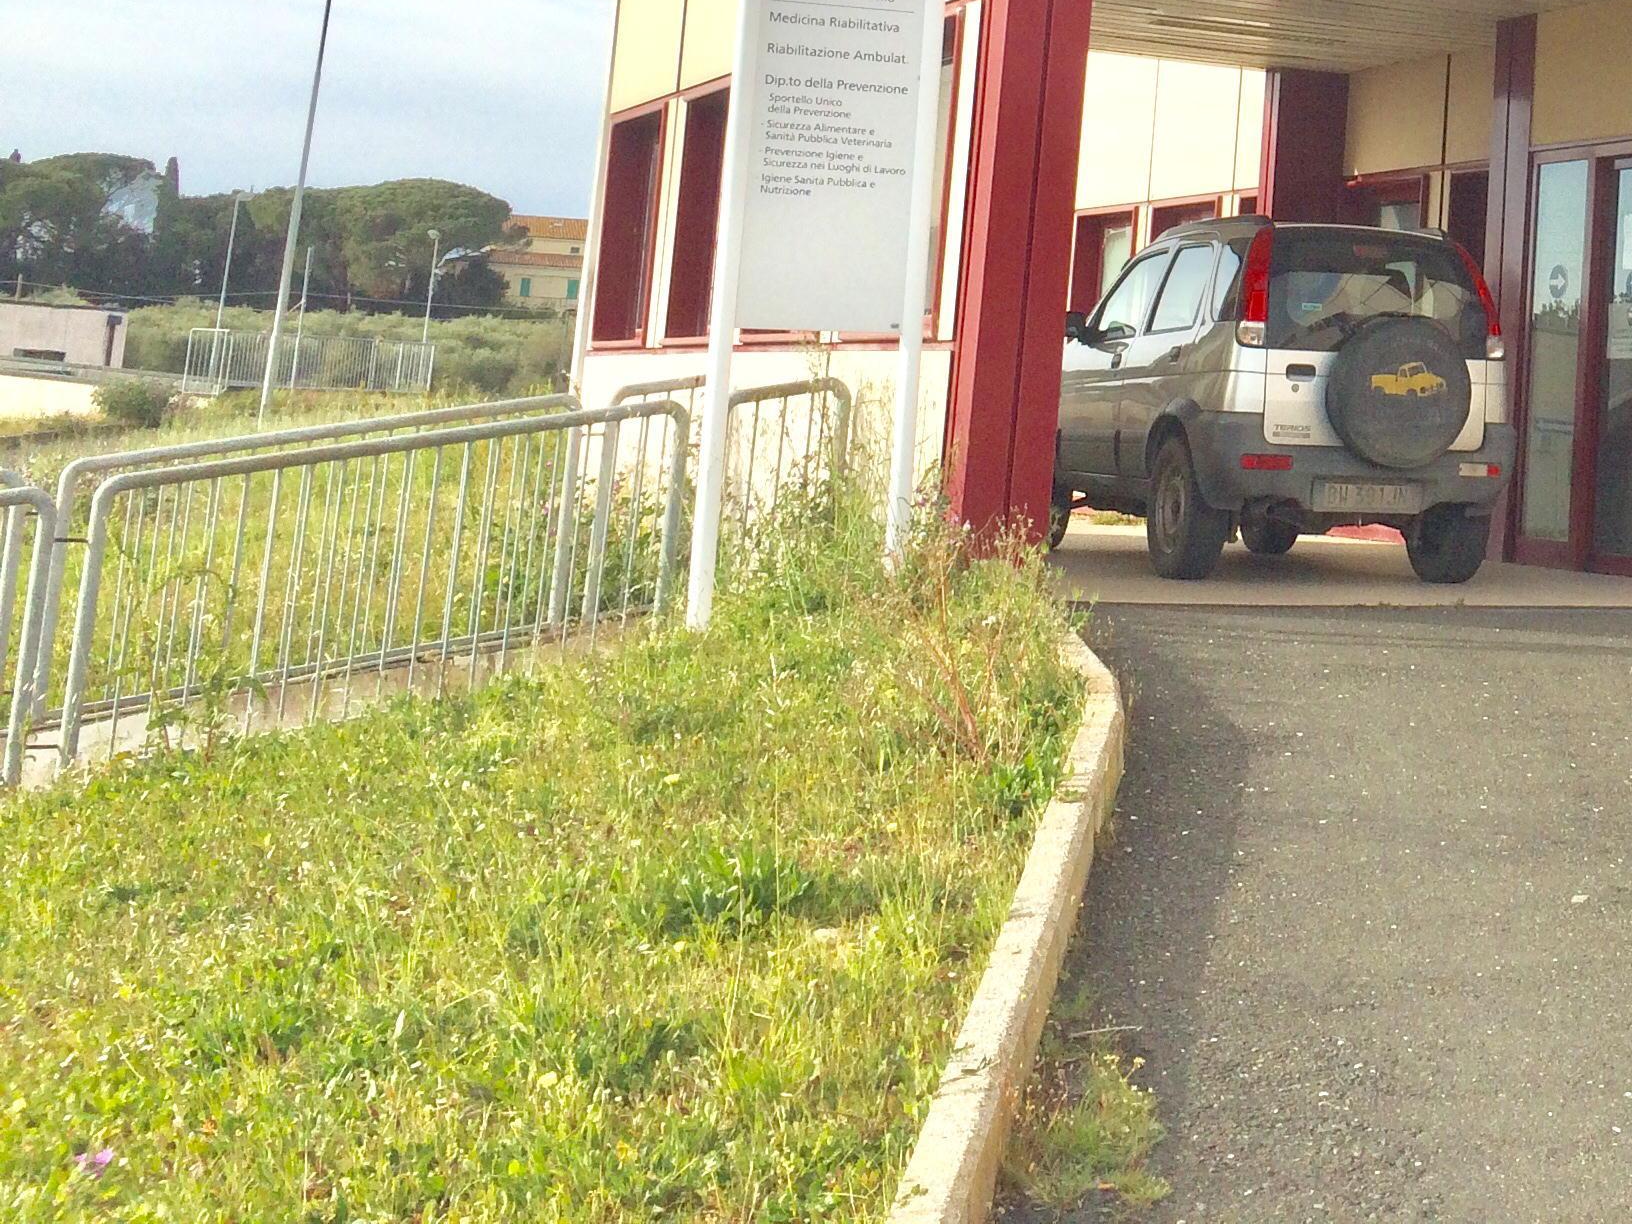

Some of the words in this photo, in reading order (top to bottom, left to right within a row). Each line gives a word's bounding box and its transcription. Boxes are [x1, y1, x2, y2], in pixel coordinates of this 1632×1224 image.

[769, 11, 826, 27] Medicina
[829, 16, 901, 33] Riabilitativa
[767, 42, 850, 60] Riabilitazione
[853, 50, 910, 65] Ambulat.
[765, 74, 801, 88] Dip.to
[804, 77, 833, 90] della
[836, 79, 909, 95] Prevenzione
[768, 93, 813, 105] Sportello
[815, 96, 843, 107] Unico
[768, 104, 791, 114] della
[793, 106, 851, 119] Prevenzione
[766, 120, 811, 132] Sicurezza
[813, 123, 867, 136] Alimentare
[869, 128, 875, 136] e
[765, 130, 796, 142] Sanità
[797, 133, 838, 145] Pubblica
[841, 137, 893, 149] Veterinaria
[764, 146, 824, 159] Prevenzione
[826, 150, 855, 162] Igiene
[857, 154, 864, 162] e
[763, 157, 808, 169] Sicurezza
[810, 162, 825, 171] nei
[827, 162, 860, 175] Luoghi
[862, 164, 872, 174] di
[874, 165, 906, 176] Lavoro
[761, 173, 792, 185] Igiene
[826, 177, 868, 189] Pubblica
[760, 185, 812, 197] Nutrizione
